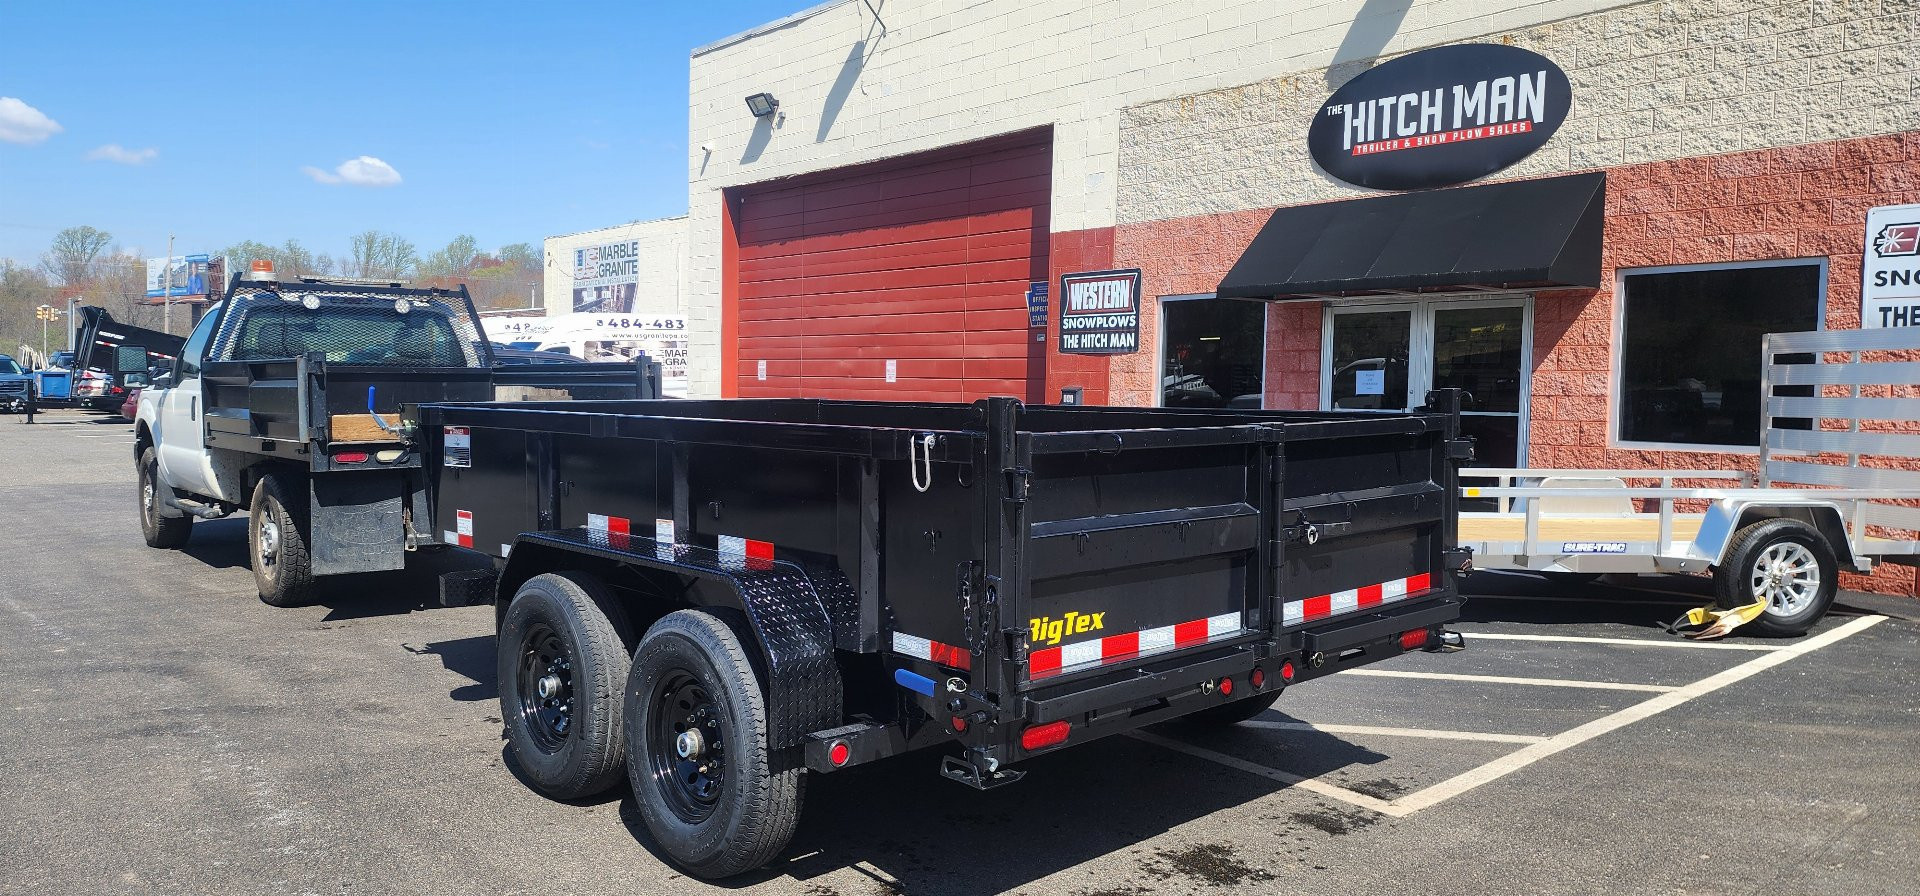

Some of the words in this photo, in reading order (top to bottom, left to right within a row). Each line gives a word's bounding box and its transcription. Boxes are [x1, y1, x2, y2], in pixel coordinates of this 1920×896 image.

[1327, 104, 1343, 116] THE
[1344, 87, 1444, 151] HITCH
[1452, 70, 1547, 129] MAN
[1357, 139, 1399, 154] TRAILER
[1404, 138, 1411, 147] &
[1417, 133, 1447, 146] SNOW
[1453, 128, 1483, 141] PLOW
[1489, 122, 1527, 136] SALES
[598, 242, 638, 261] MARBLE
[598, 260, 638, 278] GRANITE
[1070, 279, 1130, 311] WESTERN
[1062, 315, 1136, 330] SNOWPLOWS
[1878, 305, 1920, 328] THE
[1063, 334, 1079, 349] THE
[1081, 333, 1108, 348] HITCH
[1109, 332, 1135, 348] MAN
[1562, 543, 1626, 553] SURE-TRAC
